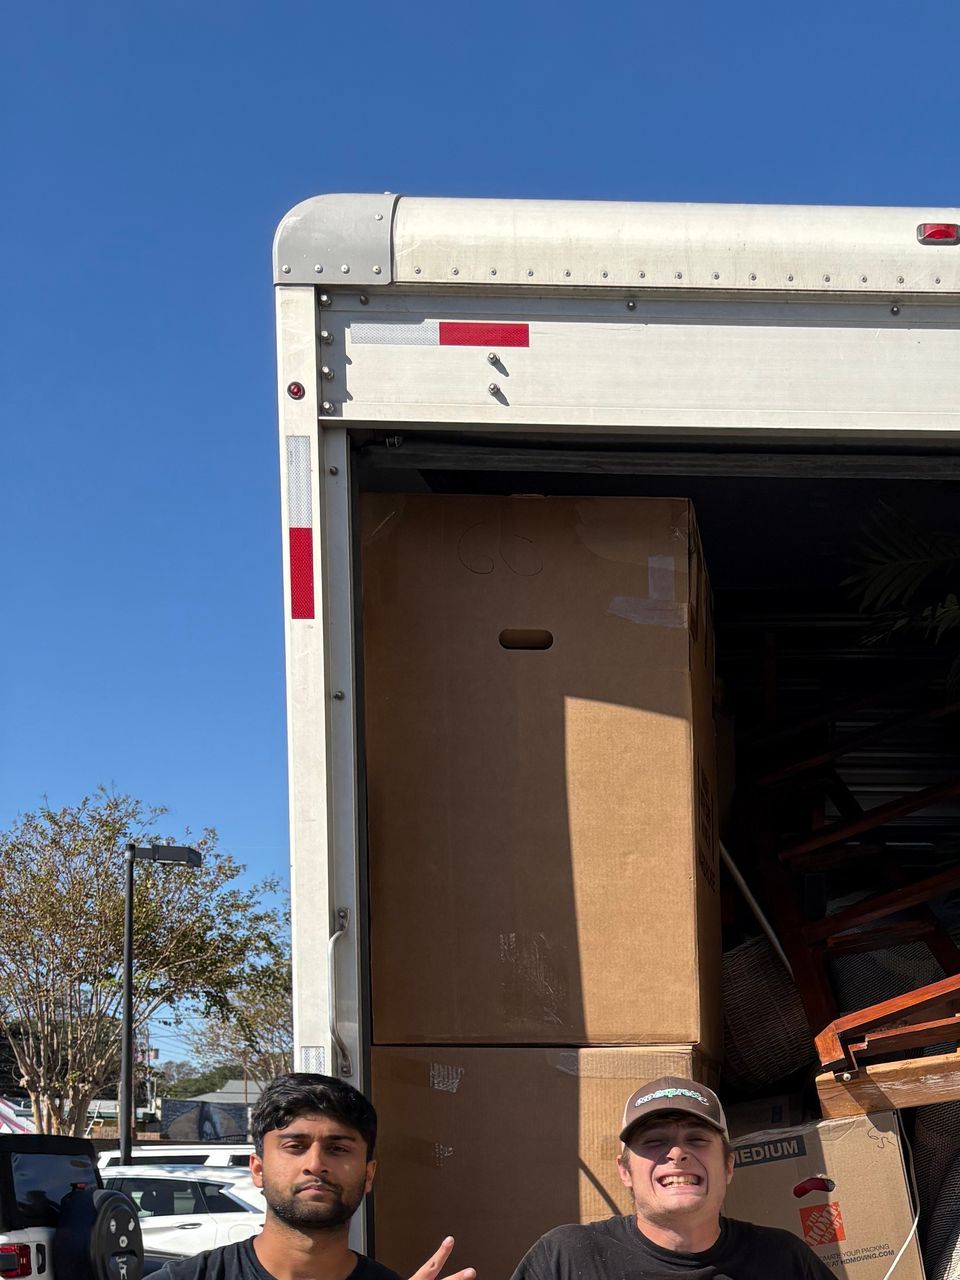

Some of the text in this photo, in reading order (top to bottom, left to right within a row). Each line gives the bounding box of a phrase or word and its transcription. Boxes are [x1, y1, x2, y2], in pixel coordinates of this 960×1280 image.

[806, 1205, 840, 1247] HOME
[808, 1211, 820, 1227] THE
[821, 1218, 843, 1243] DEPOT
[832, 1249, 895, 1267] AT HDMOVING.COM
[842, 1248, 861, 1258] YOUR
[861, 1243, 891, 1254] PACKING
